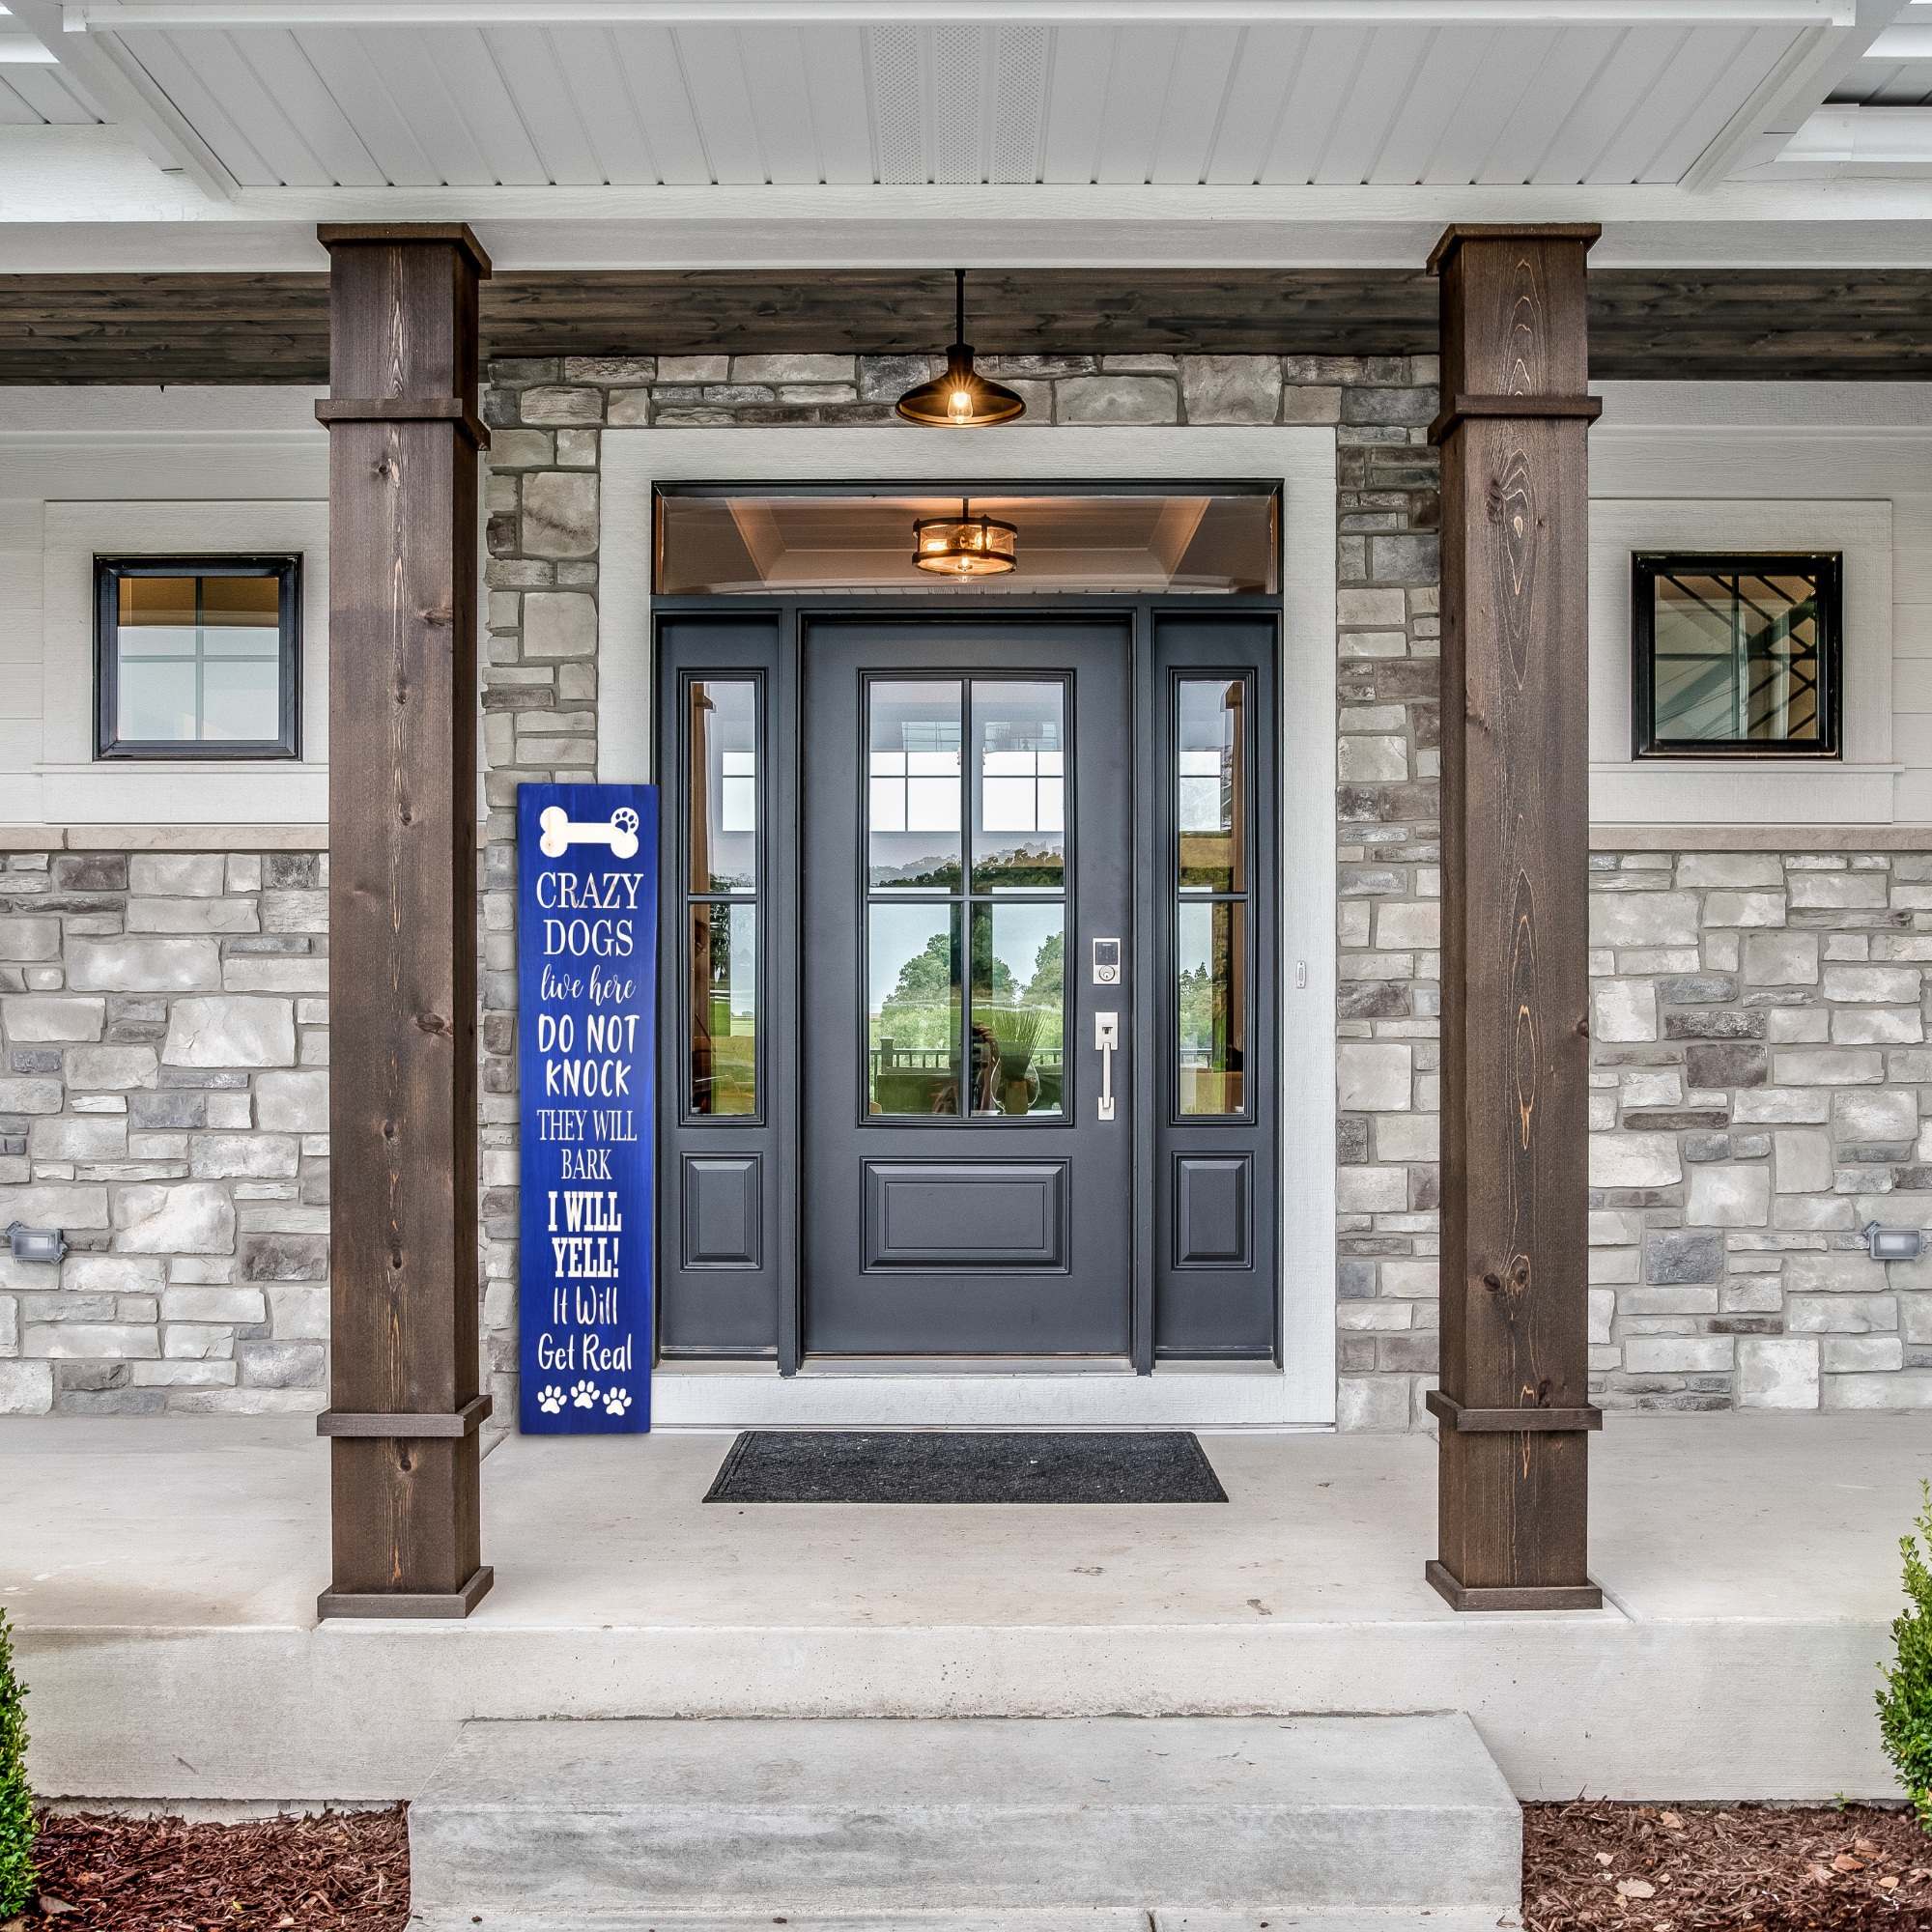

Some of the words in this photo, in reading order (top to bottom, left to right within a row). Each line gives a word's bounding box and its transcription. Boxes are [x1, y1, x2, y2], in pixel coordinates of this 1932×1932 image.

[536, 871, 644, 909] CRAZY
[543, 919, 634, 956] DOGS
[541, 963, 584, 1001] live
[589, 964, 637, 1006] here
[538, 1013, 575, 1053] DO
[587, 1014, 640, 1054] NOT
[546, 1059, 632, 1097] KNOCK
[537, 1109, 588, 1141] THEY
[592, 1110, 638, 1141] WILL
[560, 1149, 613, 1180] BARK
[548, 1190, 558, 1232] I
[564, 1190, 622, 1232] WILL
[552, 1236, 619, 1278] YELL!
[554, 1287, 568, 1325] It
[576, 1285, 619, 1325] Will
[537, 1333, 576, 1371] Get
[582, 1333, 633, 1372] Real
